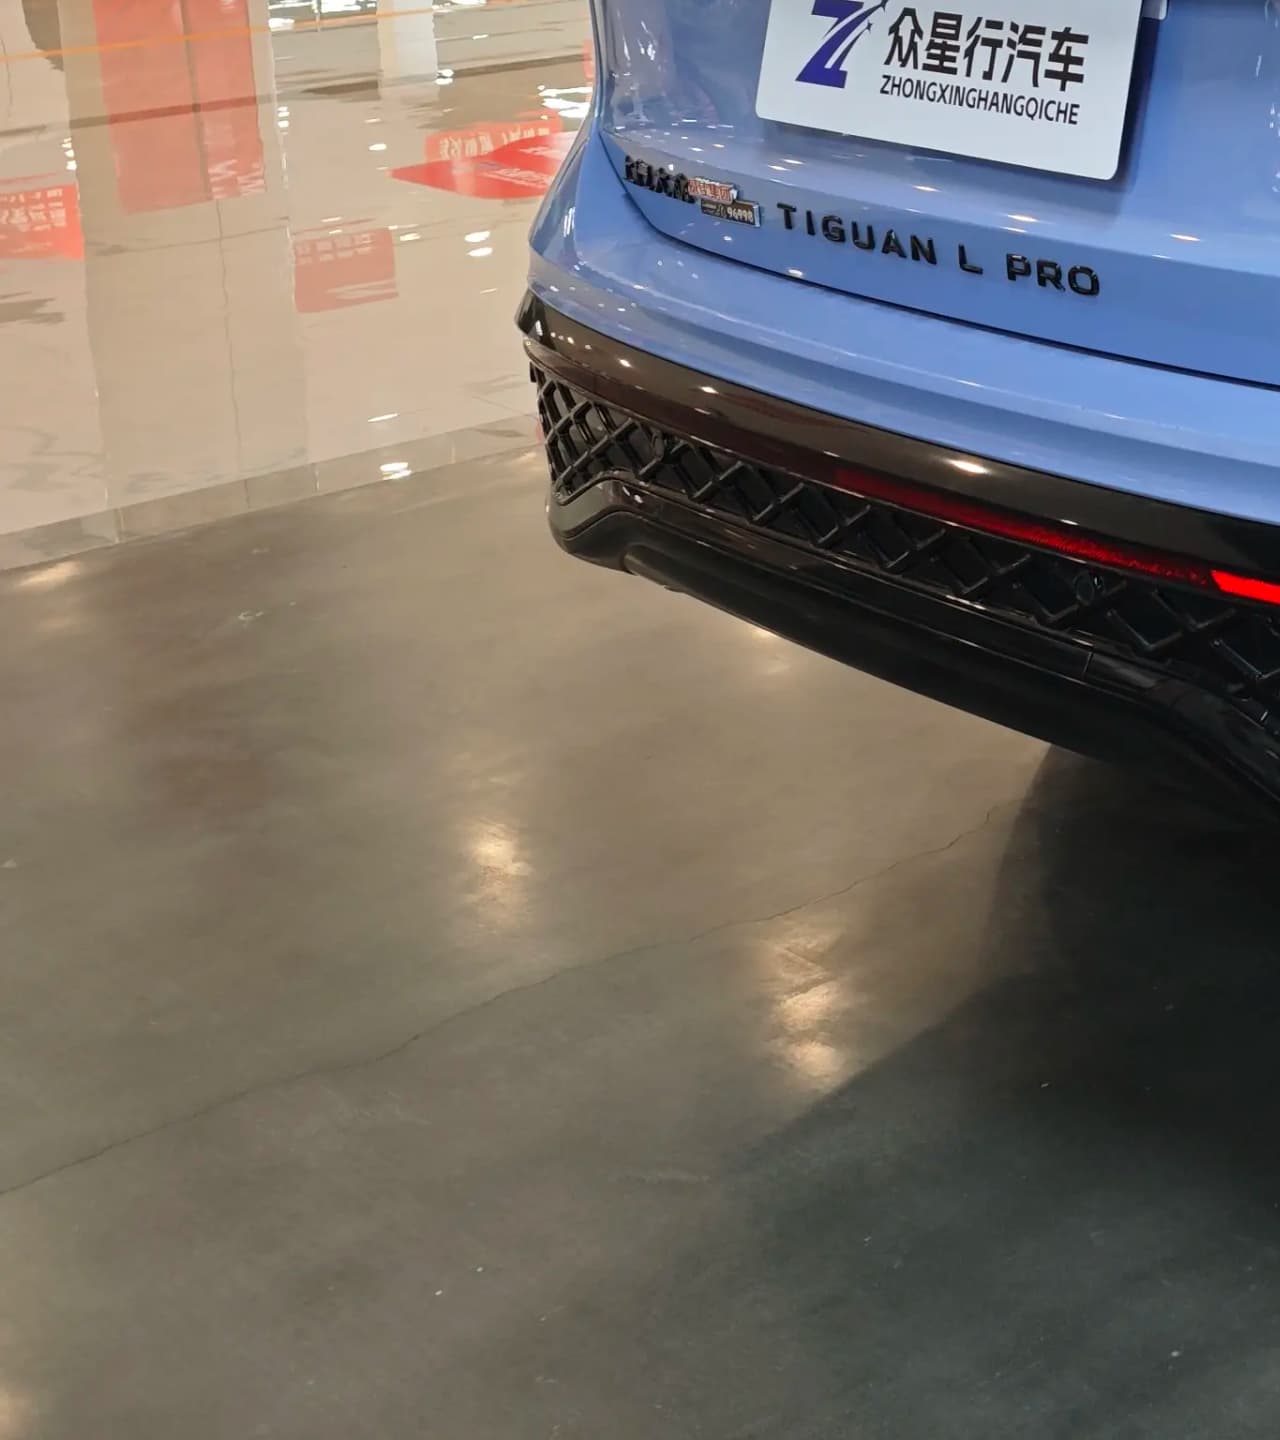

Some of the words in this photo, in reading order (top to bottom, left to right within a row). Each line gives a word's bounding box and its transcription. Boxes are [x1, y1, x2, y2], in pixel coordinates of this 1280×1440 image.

[883, 6, 1090, 92] 众星行汽车
[879, 74, 1081, 126] ZHONGXINGHANGQICHE
[776, 201, 938, 265] TIGUAN
[957, 243, 984, 276] L
[1005, 252, 1101, 297] PRO
